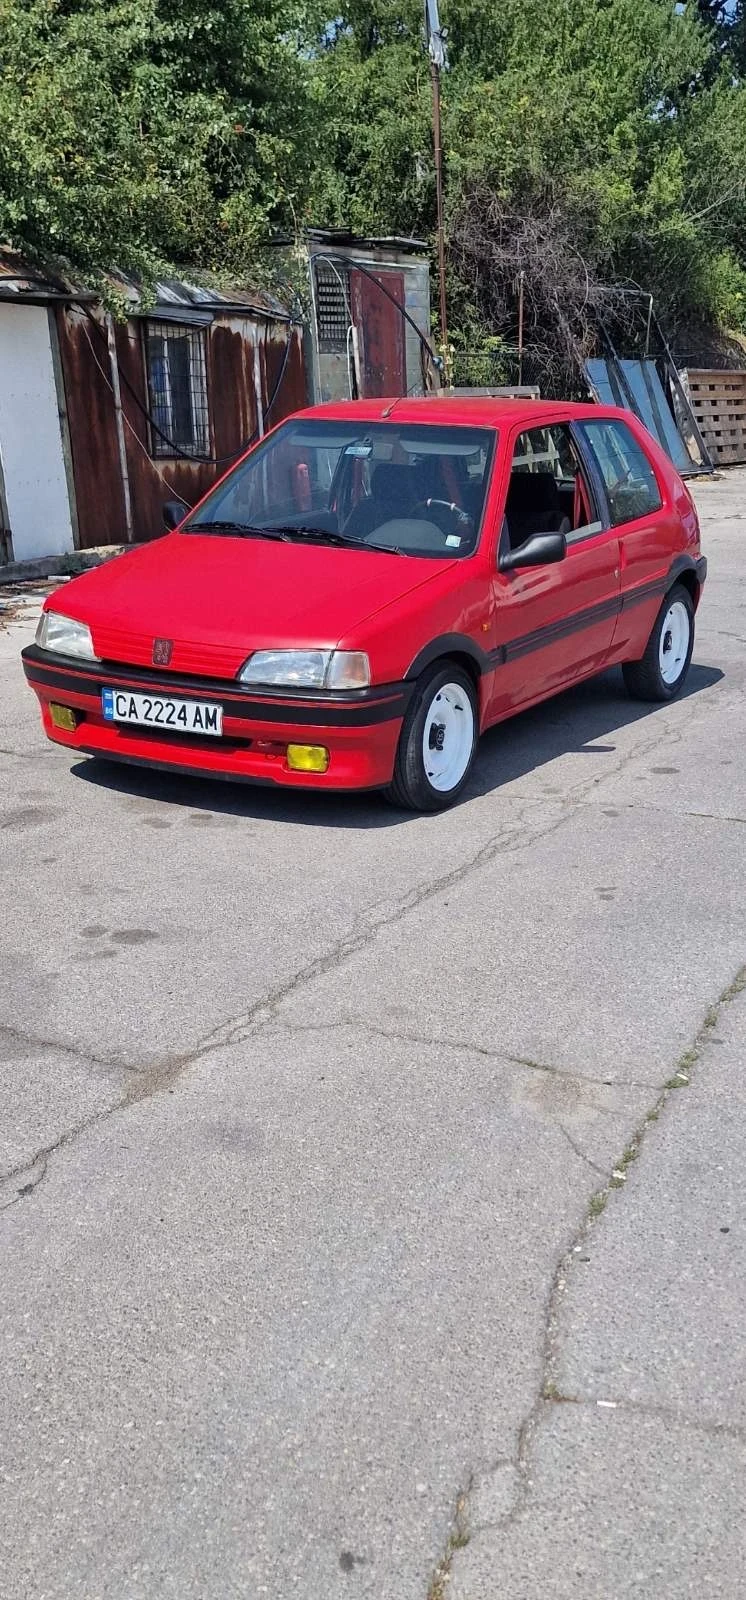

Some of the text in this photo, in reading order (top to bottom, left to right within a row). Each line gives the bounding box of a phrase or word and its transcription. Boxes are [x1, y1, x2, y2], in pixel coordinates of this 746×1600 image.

[116, 695, 217, 730] CA 2224 AM
